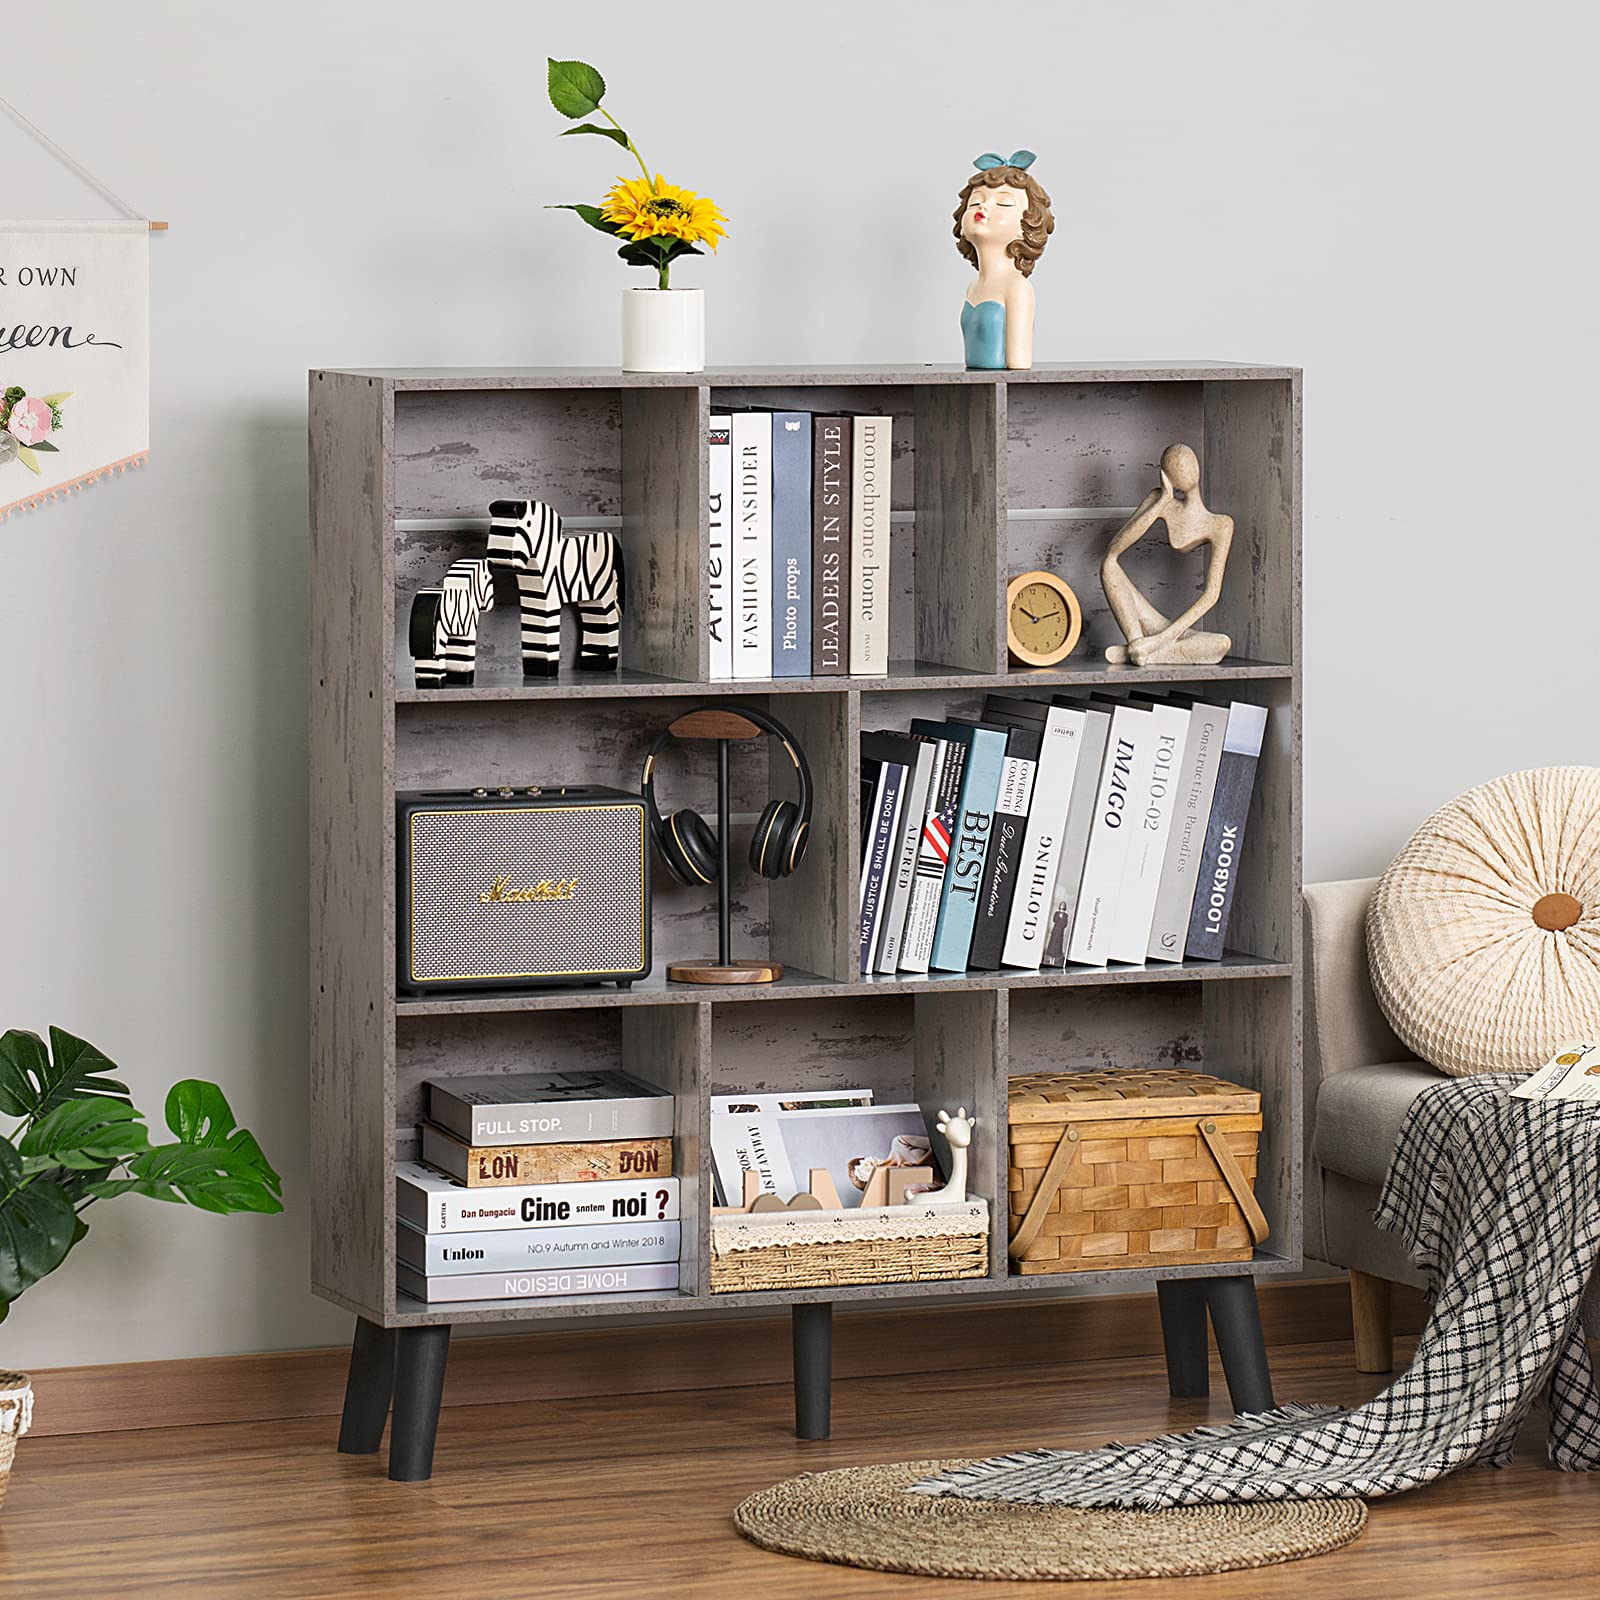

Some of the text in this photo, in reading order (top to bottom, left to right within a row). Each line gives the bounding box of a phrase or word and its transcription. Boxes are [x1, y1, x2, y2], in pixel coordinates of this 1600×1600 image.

[18, 267, 77, 286] OWN
[823, 426, 841, 667] LEADERS IN STYLE
[862, 425, 881, 620] monochrome home
[743, 558, 757, 648] FASHION
[783, 558, 800, 650] Photo props
[1054, 727, 1075, 738] Better
[1002, 760, 1018, 811] COMMUTE
[1014, 762, 1029, 813] COVERING
[1104, 737, 1135, 829] IMAGO
[1143, 735, 1176, 831] FOLIO-02
[1177, 722, 1215, 873] Constructing Paradies
[860, 788, 895, 945] THAT JUSTICE SHALL BE DONE
[899, 824, 918, 888] ALPRED
[950, 809, 990, 903] BEST
[1022, 835, 1052, 941] CLOTHING
[1205, 825, 1238, 934] LOOKBOOK
[477, 1118, 562, 1136] FULL STOP.
[747, 1125, 776, 1189] IS IT ANYWAY
[479, 1154, 519, 1179] LON
[619, 1149, 660, 1173] DON
[461, 1209, 477, 1219] Dan
[479, 1207, 516, 1219] Dungaciu
[521, 1197, 570, 1222] Cine
[612, 1192, 647, 1217] noi
[442, 1248, 485, 1261] Union
[528, 1236, 665, 1254] NO.9 Autumn and Winter 2018
[576, 1271, 628, 1290] HOME
